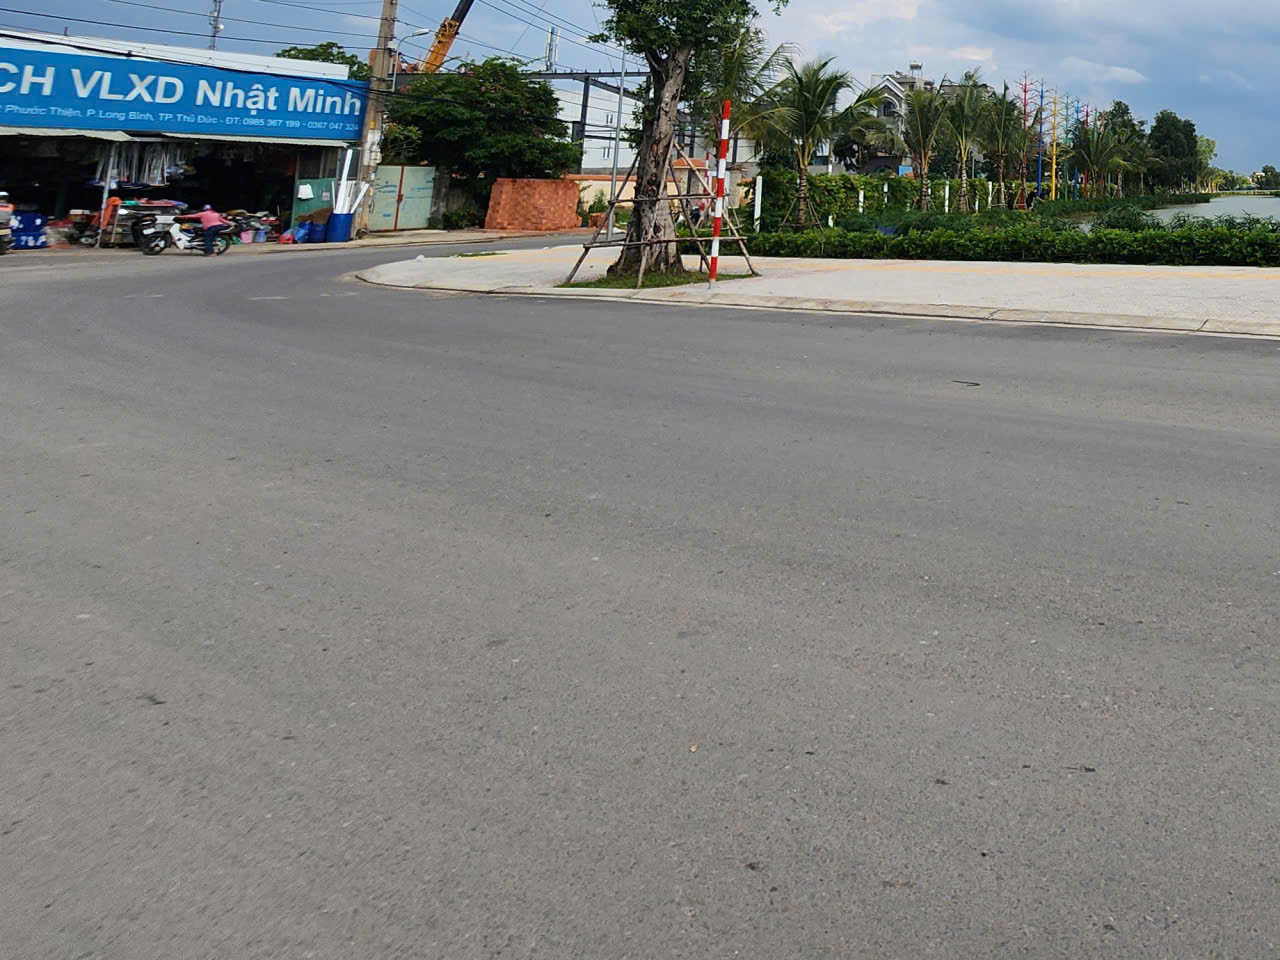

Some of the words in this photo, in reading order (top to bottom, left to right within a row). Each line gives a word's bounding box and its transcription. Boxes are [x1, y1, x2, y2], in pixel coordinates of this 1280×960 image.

[71, 68, 184, 104] VLXD
[195, 79, 279, 116] Nhật
[287, 87, 361, 116] Minh
[266, 119, 283, 127] 367
